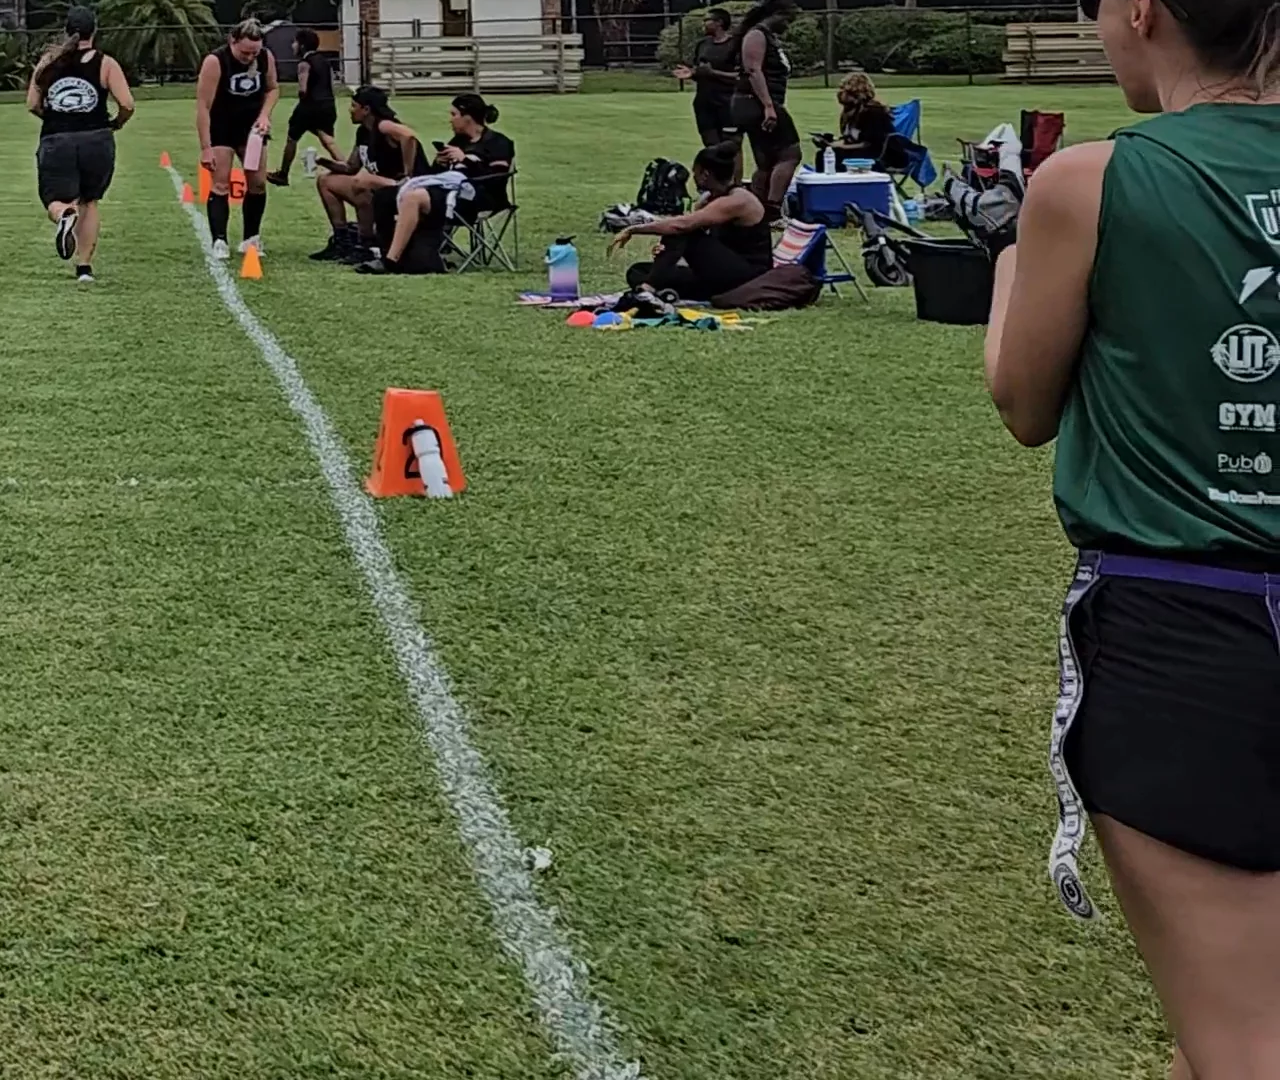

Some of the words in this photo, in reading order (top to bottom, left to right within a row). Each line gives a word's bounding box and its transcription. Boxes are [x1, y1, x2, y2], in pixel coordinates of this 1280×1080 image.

[229, 181, 244, 199] G
[1219, 402, 1276, 427] GYM
[1055, 613, 1080, 719] OUTH
